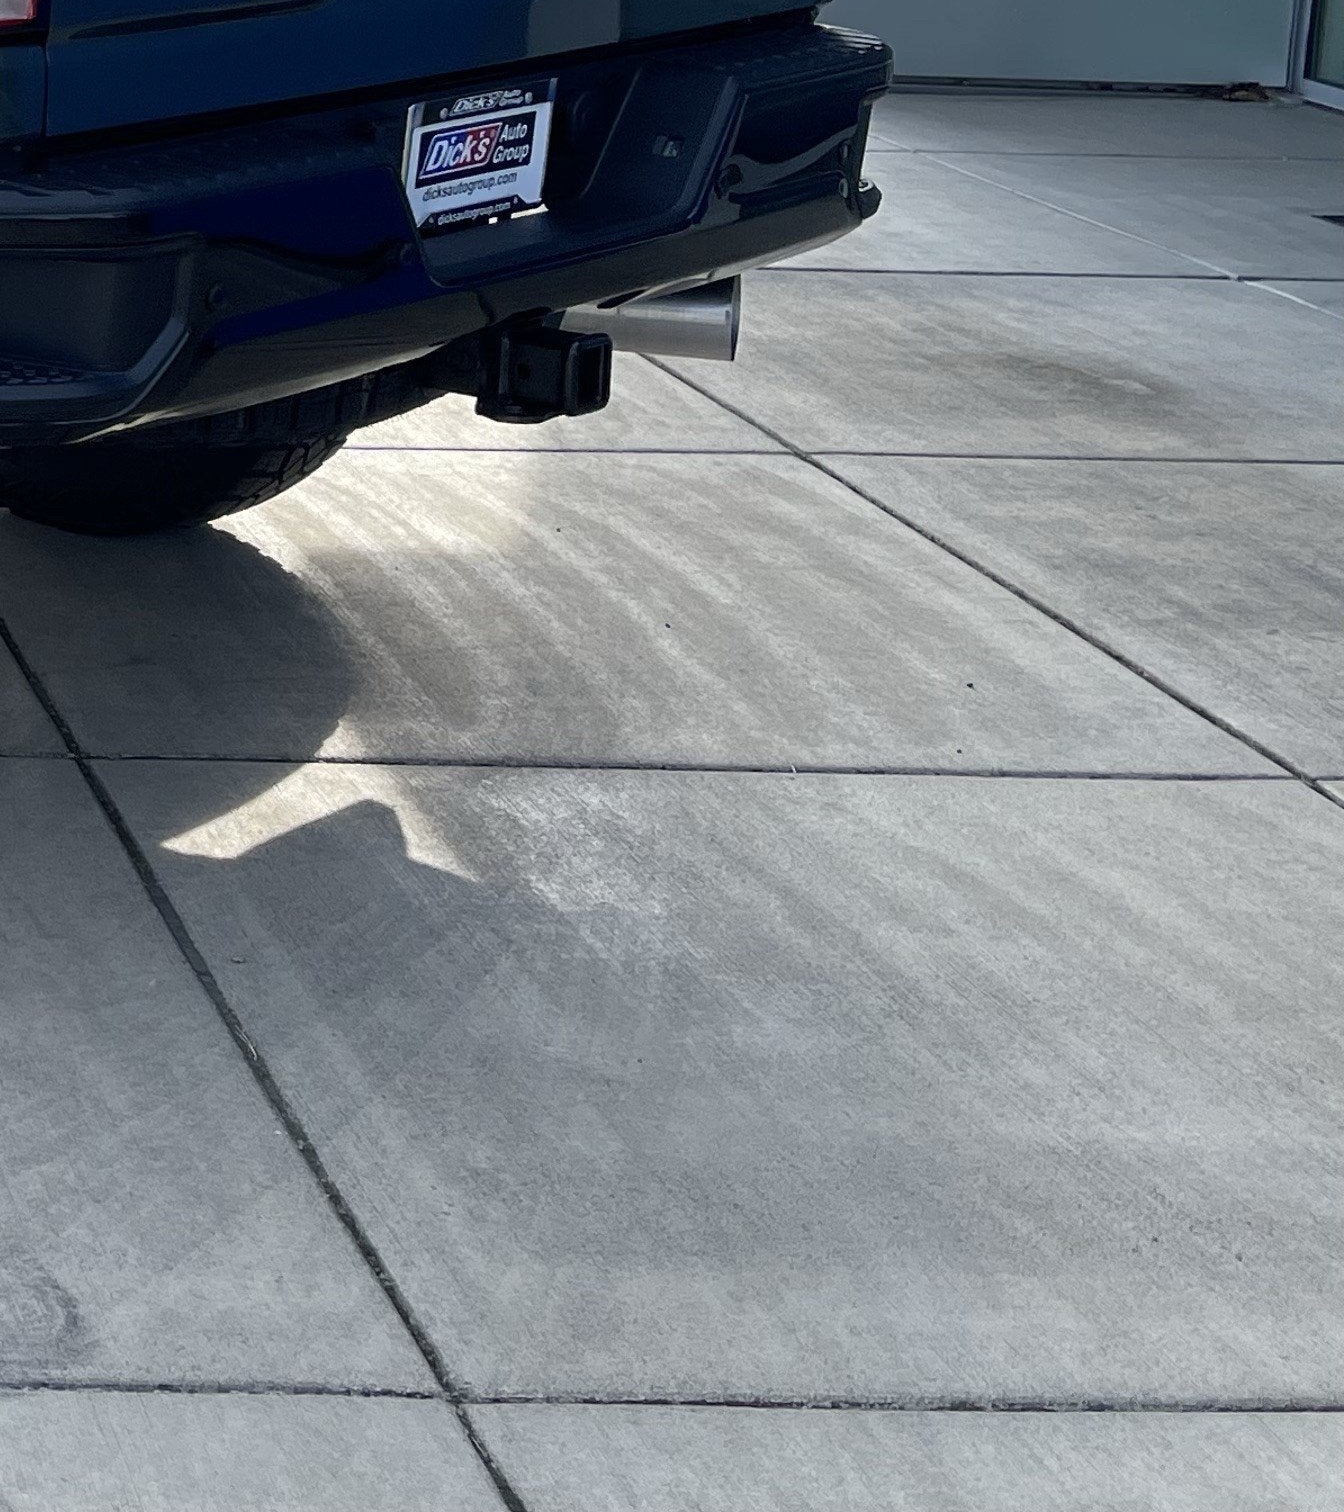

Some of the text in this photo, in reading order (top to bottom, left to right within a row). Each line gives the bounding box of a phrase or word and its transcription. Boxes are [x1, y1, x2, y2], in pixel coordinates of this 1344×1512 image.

[500, 122, 528, 142] Auto
[424, 131, 491, 172] Dick's
[492, 143, 530, 164] Group
[422, 171, 518, 202] dicksautogroup.com
[437, 201, 511, 225] dicksautogroup.com
